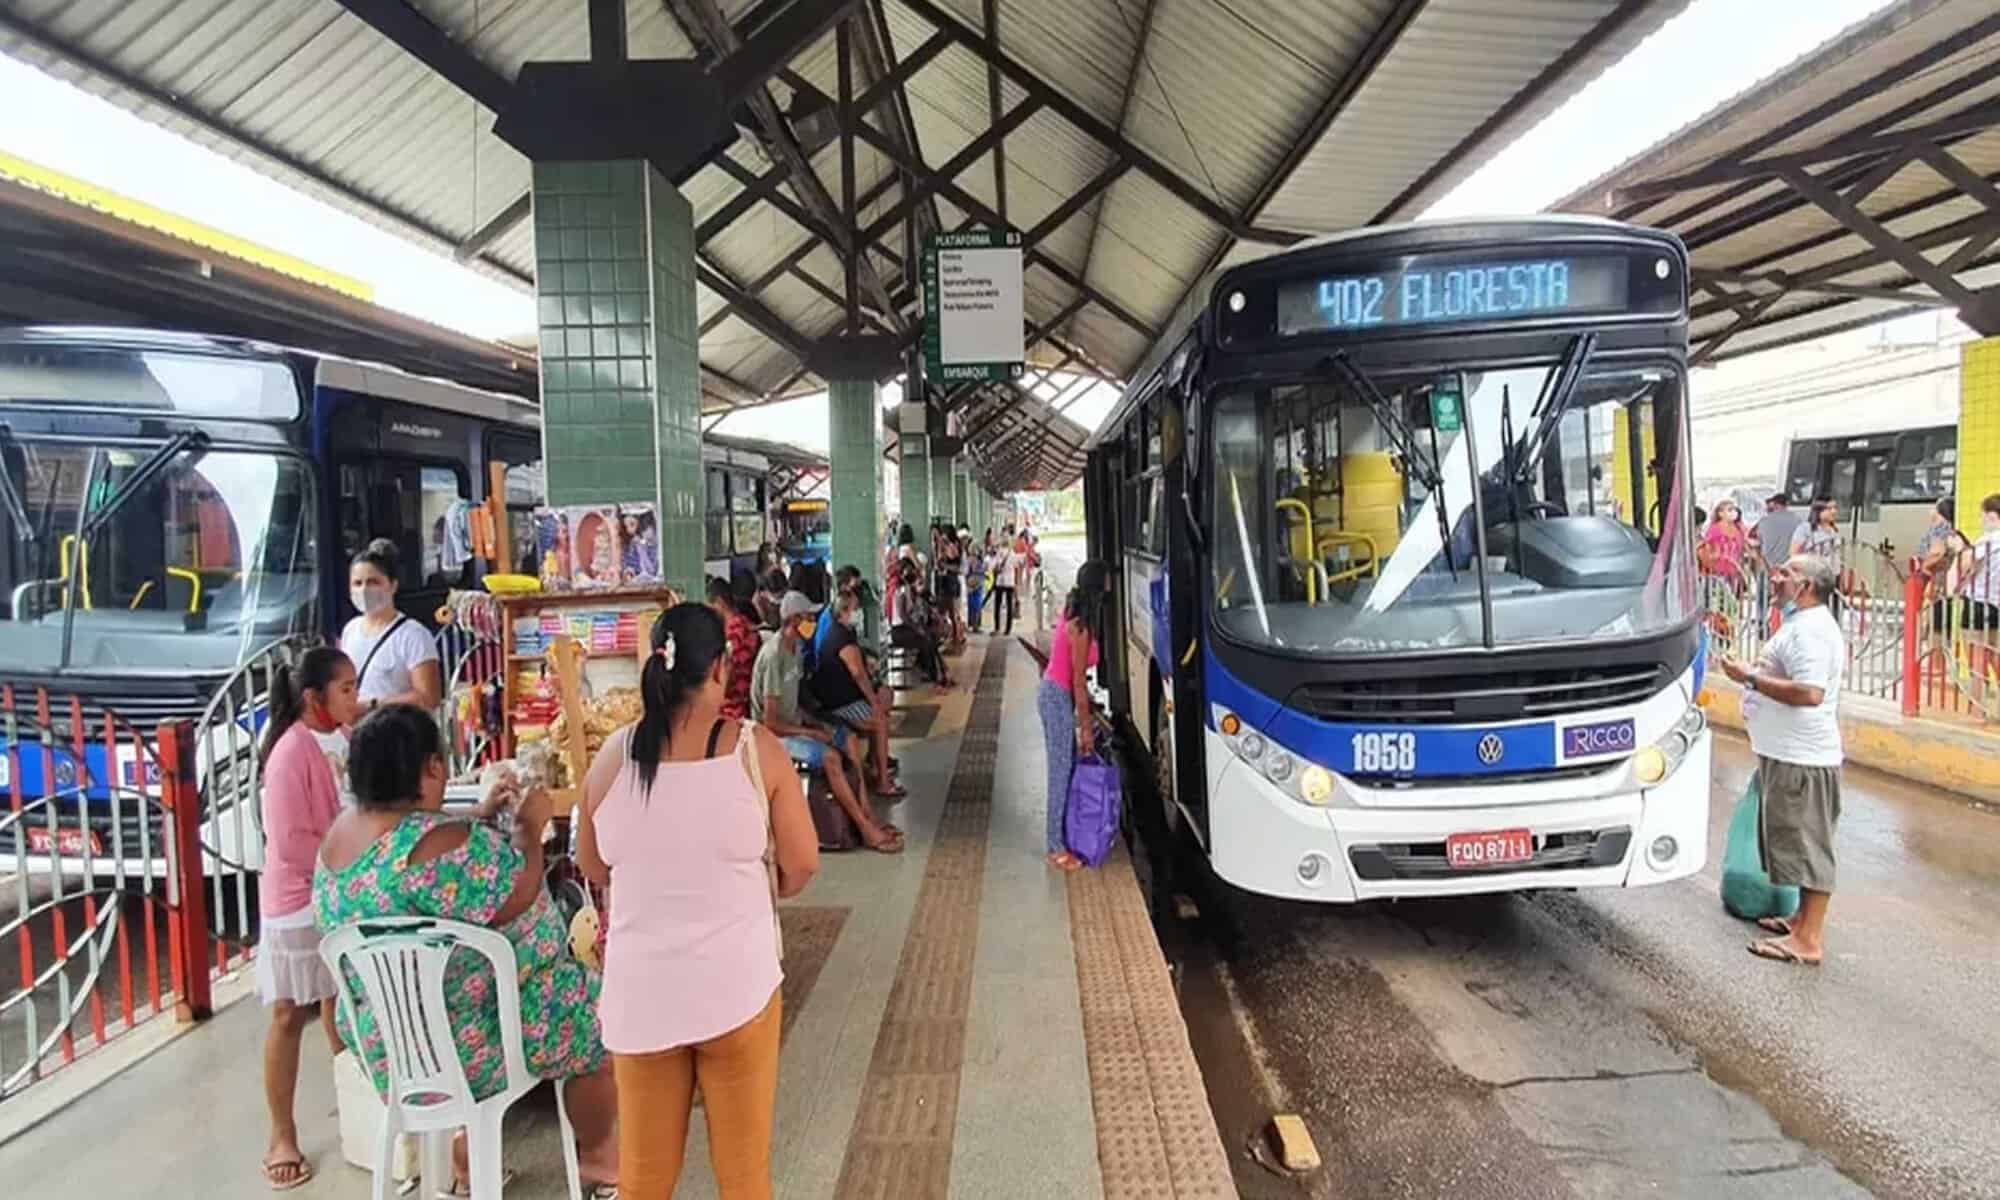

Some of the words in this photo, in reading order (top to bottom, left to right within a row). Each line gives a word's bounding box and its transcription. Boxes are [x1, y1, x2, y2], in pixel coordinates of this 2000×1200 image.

[1318, 278, 1384, 327] 402
[1400, 260, 1570, 321] FLORESTA
[1351, 731, 1416, 772] 1958
[1568, 724, 1634, 753] RICCO
